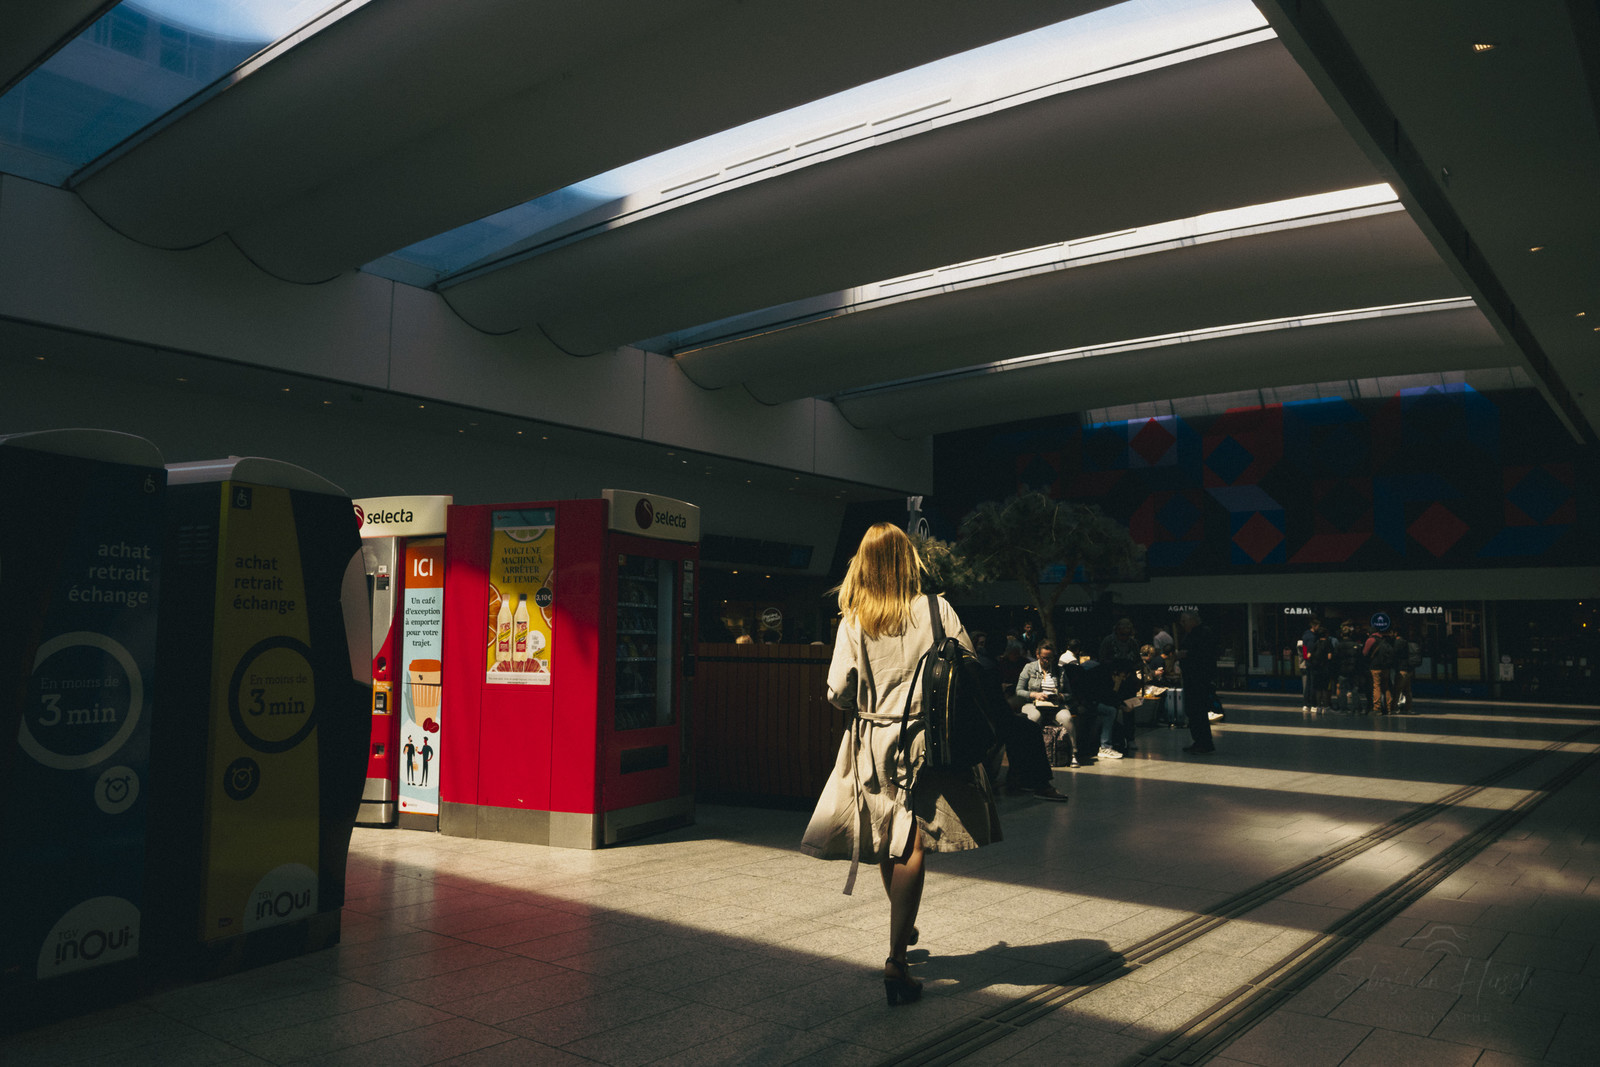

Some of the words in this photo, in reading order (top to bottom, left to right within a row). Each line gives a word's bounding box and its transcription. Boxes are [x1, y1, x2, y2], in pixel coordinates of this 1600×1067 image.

[367, 510, 414, 525] selecta
[655, 510, 687, 529] selecta
[98, 541, 151, 560] achat
[235, 555, 278, 571] achat
[413, 558, 434, 577] ICI
[502, 556, 536, 565] MACHINE
[88, 563, 150, 582] retrait
[502, 575, 511, 584] LE
[234, 576, 283, 591] retrait
[68, 584, 149, 608] échange
[411, 597, 421, 605] Un
[422, 596, 436, 605] café
[233, 594, 296, 615] échange
[405, 607, 441, 616] d'exception
[405, 618, 410, 626] à
[411, 618, 441, 628] emporter
[406, 629, 420, 638] pour
[422, 629, 439, 637] votre
[412, 639, 432, 648] trajet.
[40, 677, 58, 690] En
[62, 677, 101, 689] moins
[104, 675, 120, 688] de
[250, 673, 263, 686] En
[265, 674, 294, 685] moins
[296, 672, 308, 684] de
[248, 688, 265, 717] 3
[269, 697, 306, 716] min
[38, 694, 62, 727] 3
[66, 703, 117, 726] min
[258, 890, 274, 901] TGV
[58, 928, 80, 940] TGV
